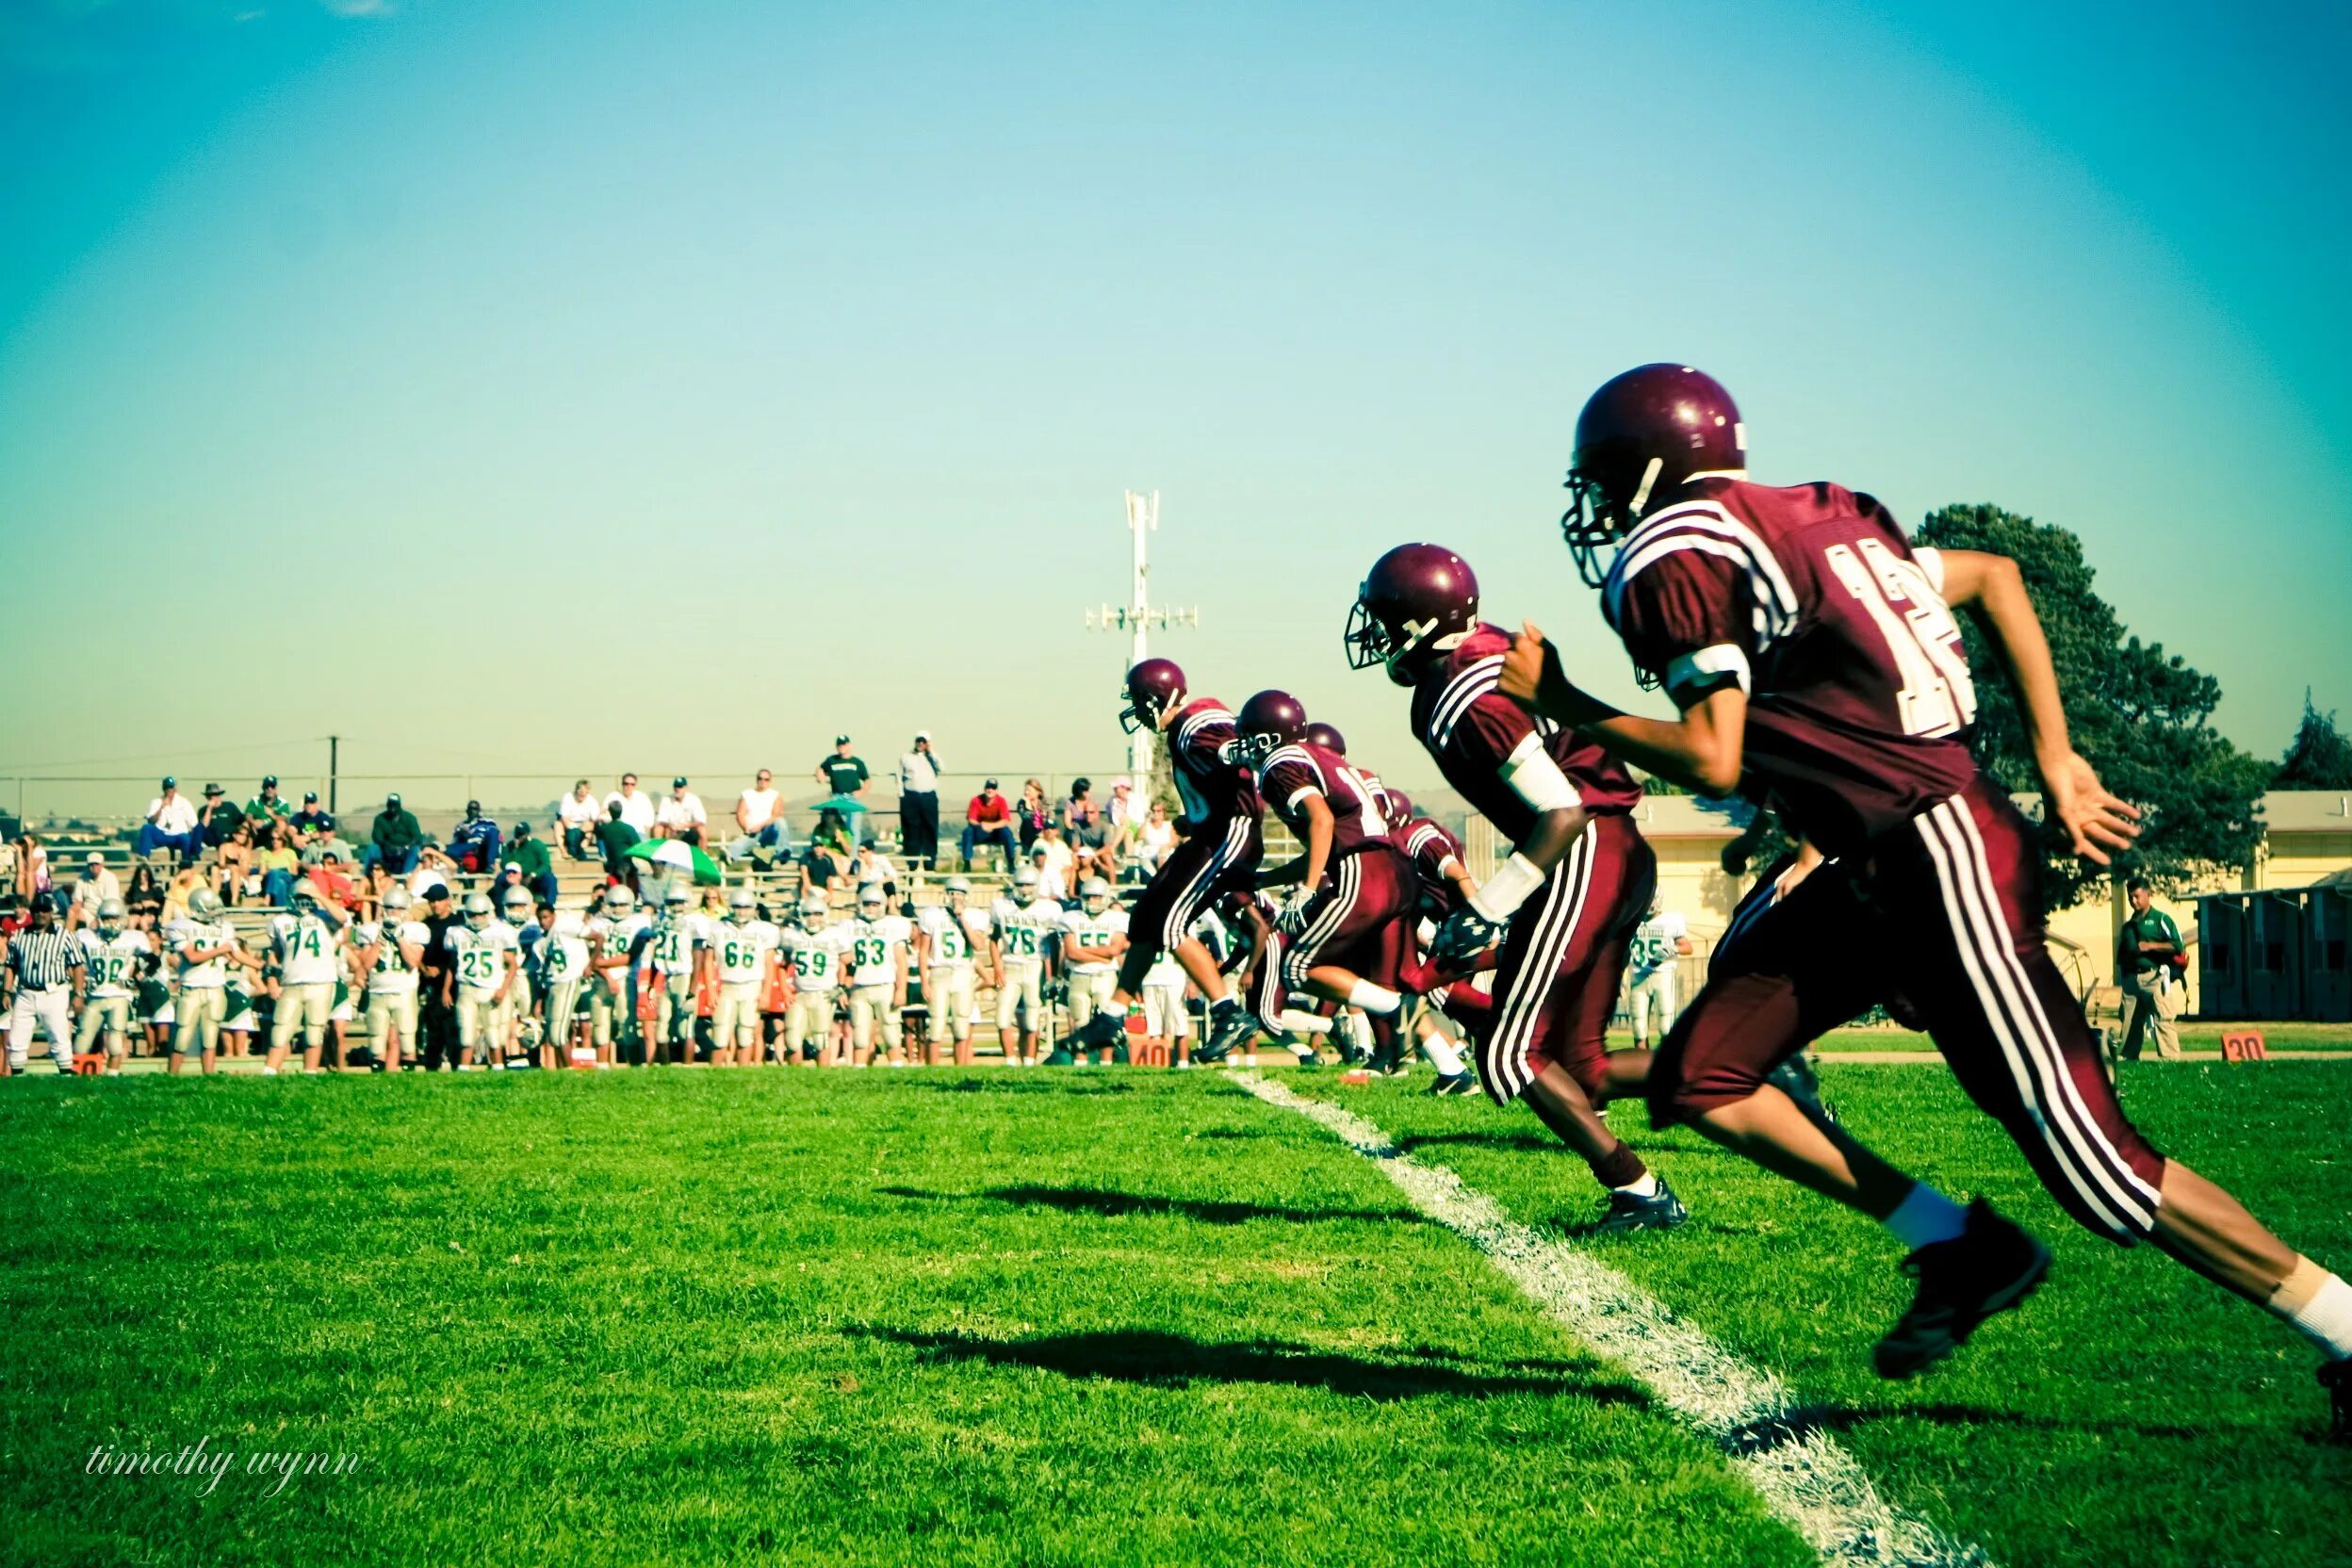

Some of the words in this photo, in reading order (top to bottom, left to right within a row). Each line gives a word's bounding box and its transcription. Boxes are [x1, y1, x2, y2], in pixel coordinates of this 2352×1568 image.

[1824, 537, 1978, 740] 12
[286, 928, 321, 961] 74
[725, 941, 756, 969] 66
[855, 939, 886, 967] 63
[463, 951, 494, 979] 25
[794, 950, 827, 976] 59
[2228, 1037, 2263, 1061] 30
